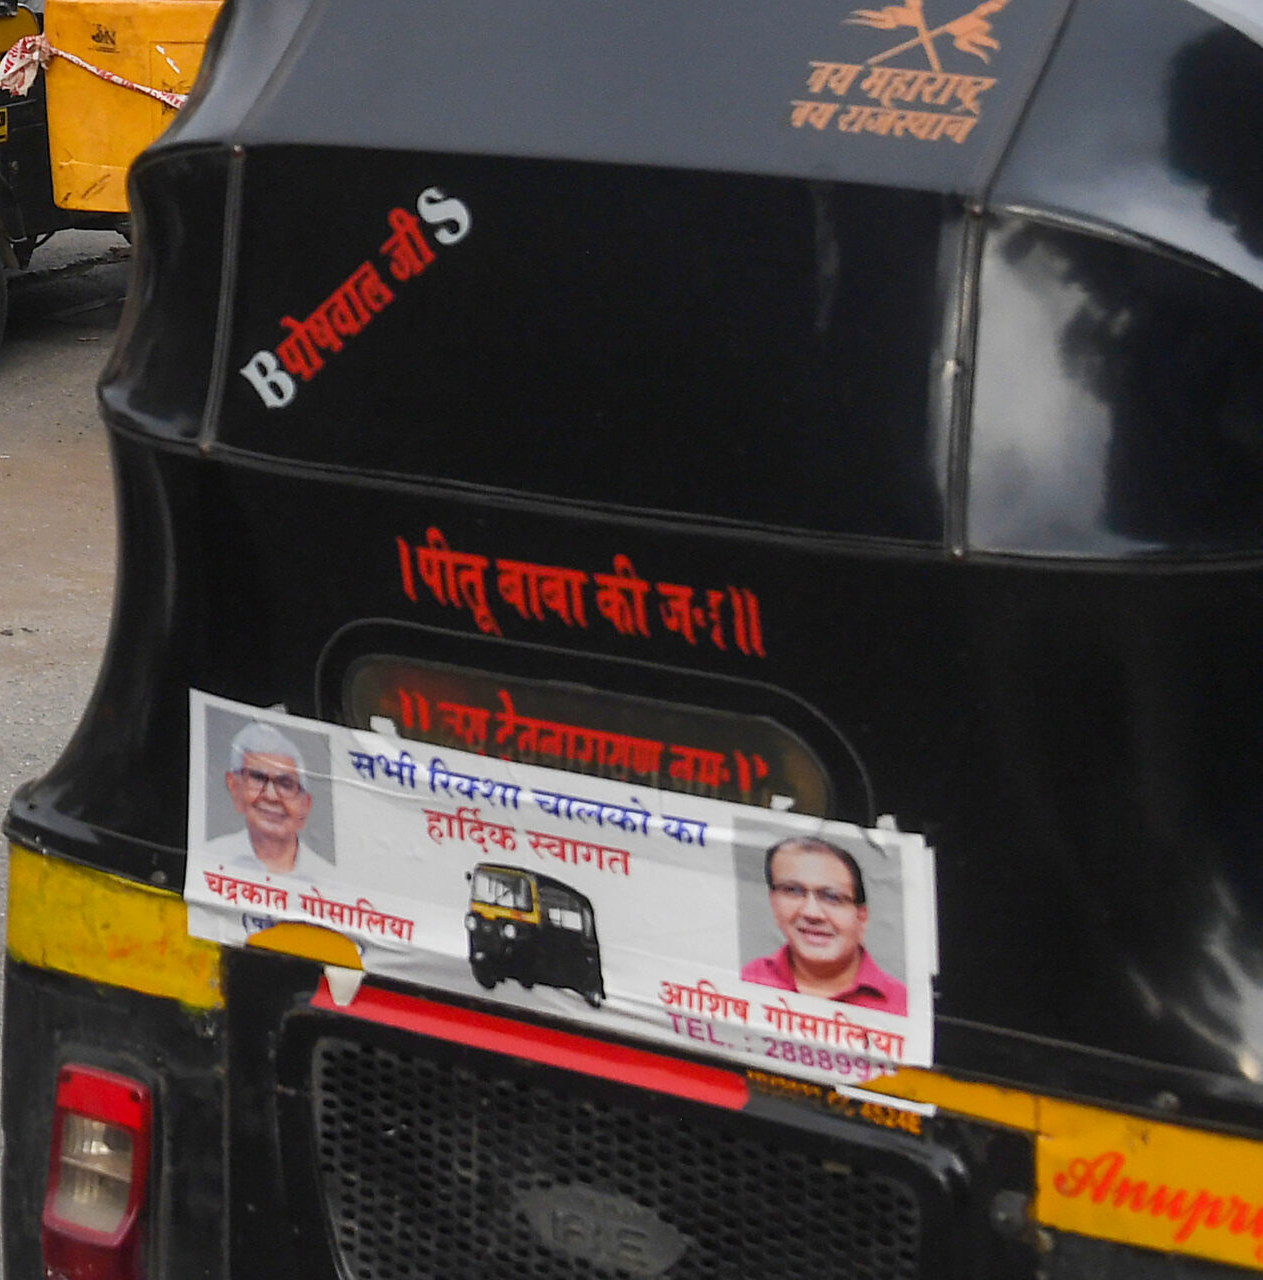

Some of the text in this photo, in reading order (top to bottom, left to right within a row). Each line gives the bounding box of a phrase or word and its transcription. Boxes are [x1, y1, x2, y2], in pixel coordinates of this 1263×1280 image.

[495, 558, 588, 628] बाबा
[593, 553, 651, 639] की
[348, 751, 416, 789] सभी
[428, 757, 521, 810] रिक्शा
[661, 813, 708, 847] का
[423, 806, 631, 876] हार्दिक स्वागत
[203, 864, 414, 941] चंद्रकांत गोसालिया
[658, 979, 905, 1059] आशिष गोसालिया
